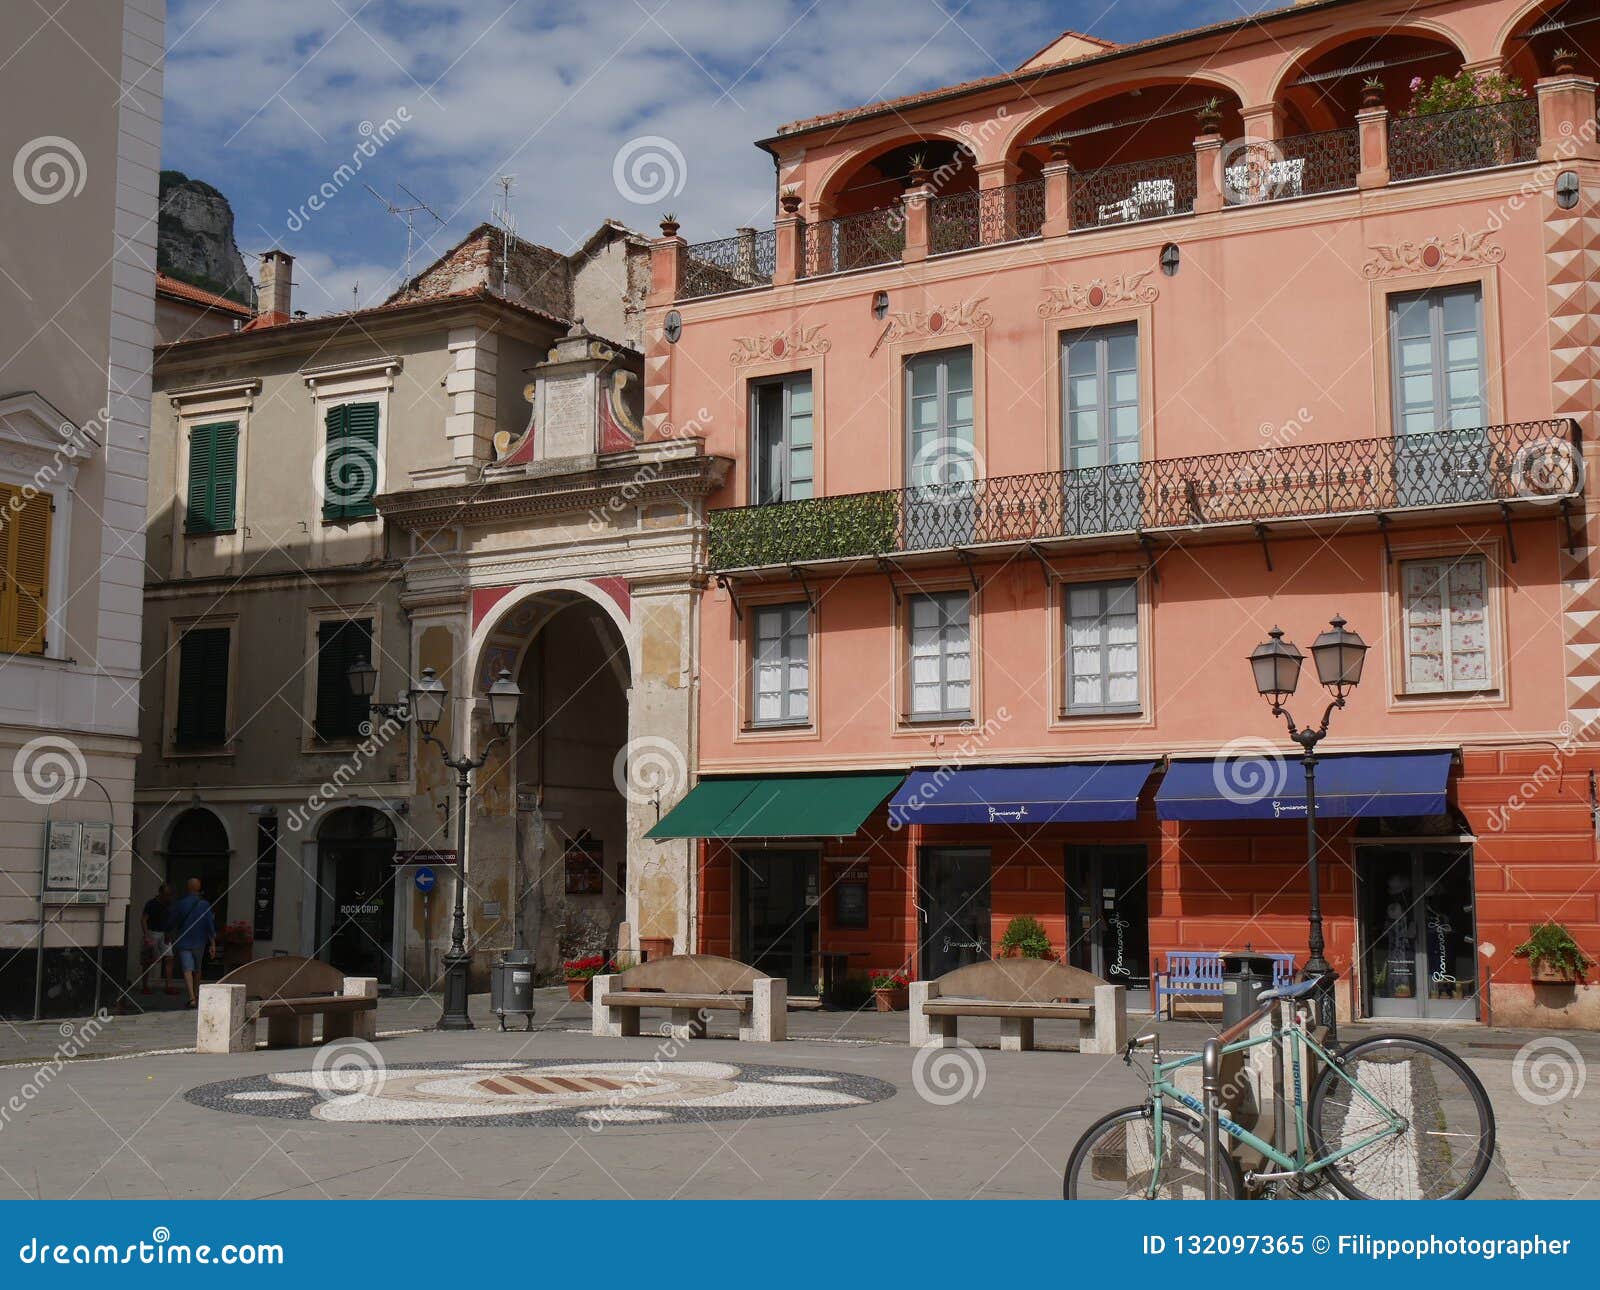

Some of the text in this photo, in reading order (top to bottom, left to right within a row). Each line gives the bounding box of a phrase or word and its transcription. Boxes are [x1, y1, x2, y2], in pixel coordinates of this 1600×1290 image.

[341, 905, 379, 913] ROCK GRIP
[1183, 1094, 1243, 1136] Bichi
